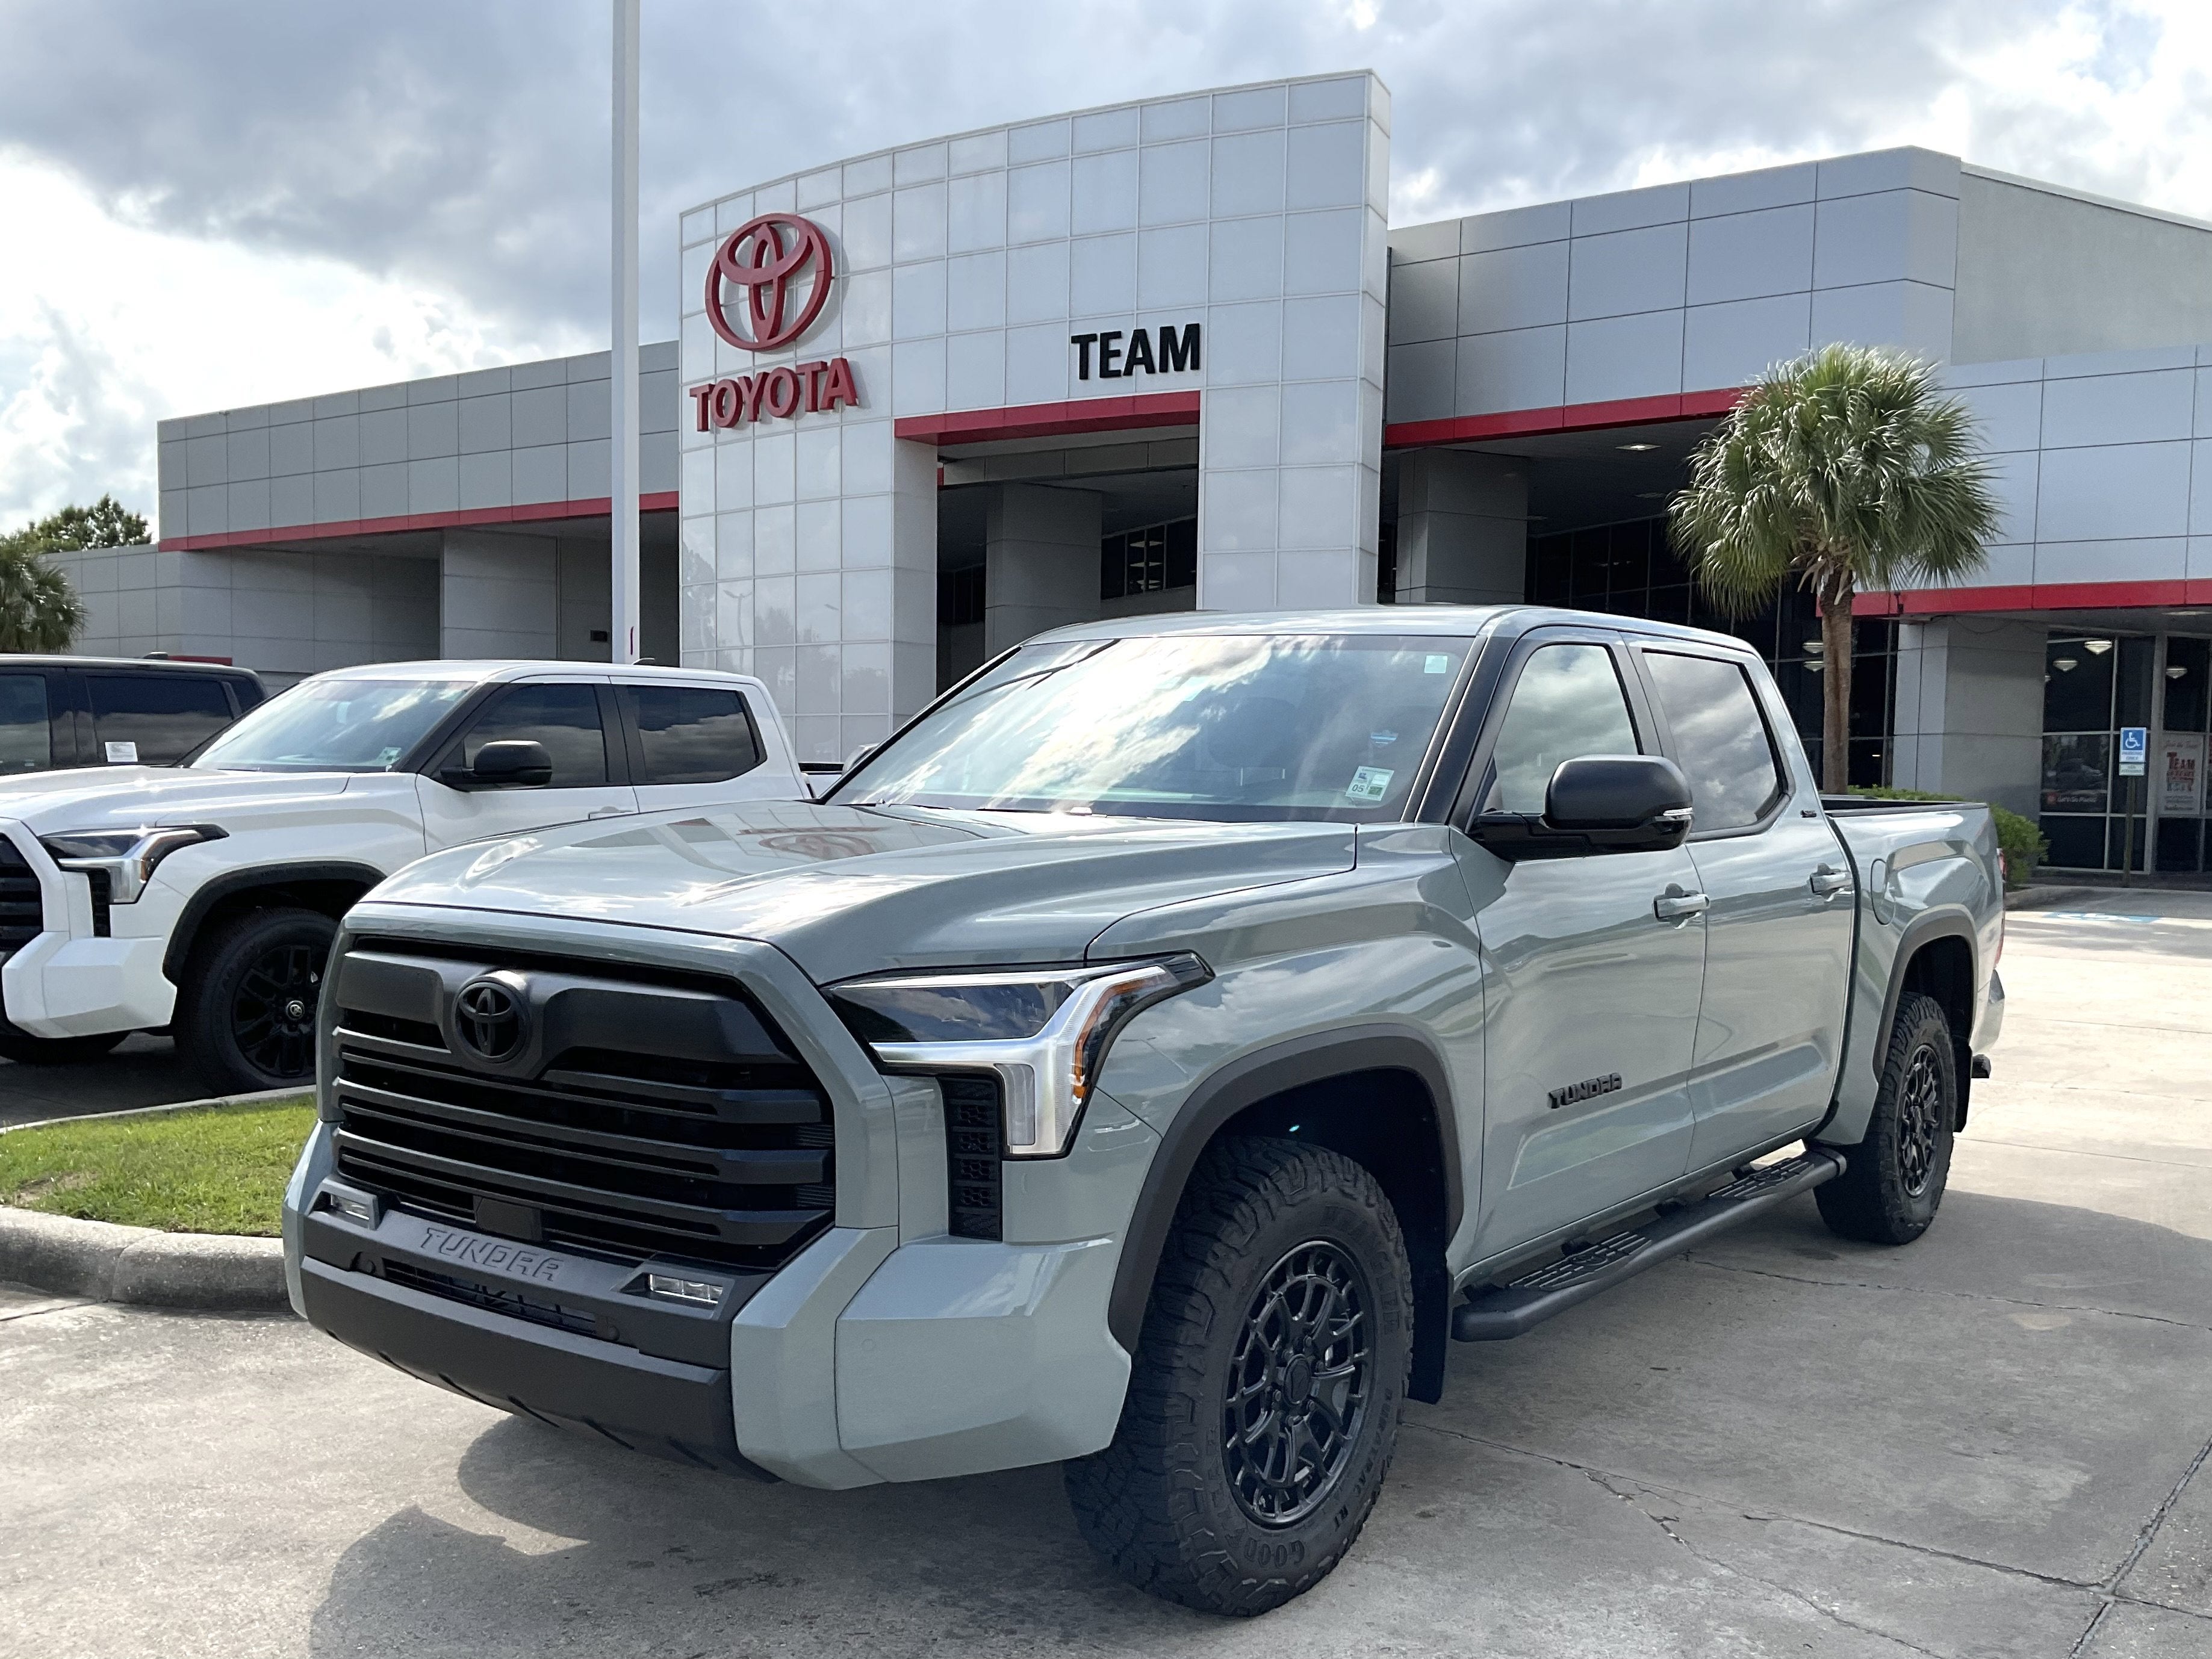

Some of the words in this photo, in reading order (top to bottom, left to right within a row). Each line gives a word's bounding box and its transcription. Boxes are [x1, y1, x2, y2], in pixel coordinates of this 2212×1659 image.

[1071, 323, 1200, 380] TEAM
[689, 357, 858, 432] TOYOTA
[1352, 784, 1365, 792] 05
[1547, 1072, 1622, 1109] TUNDRA
[420, 1227, 565, 1282] TUNDRA
[1332, 1504, 1350, 1533] RT
